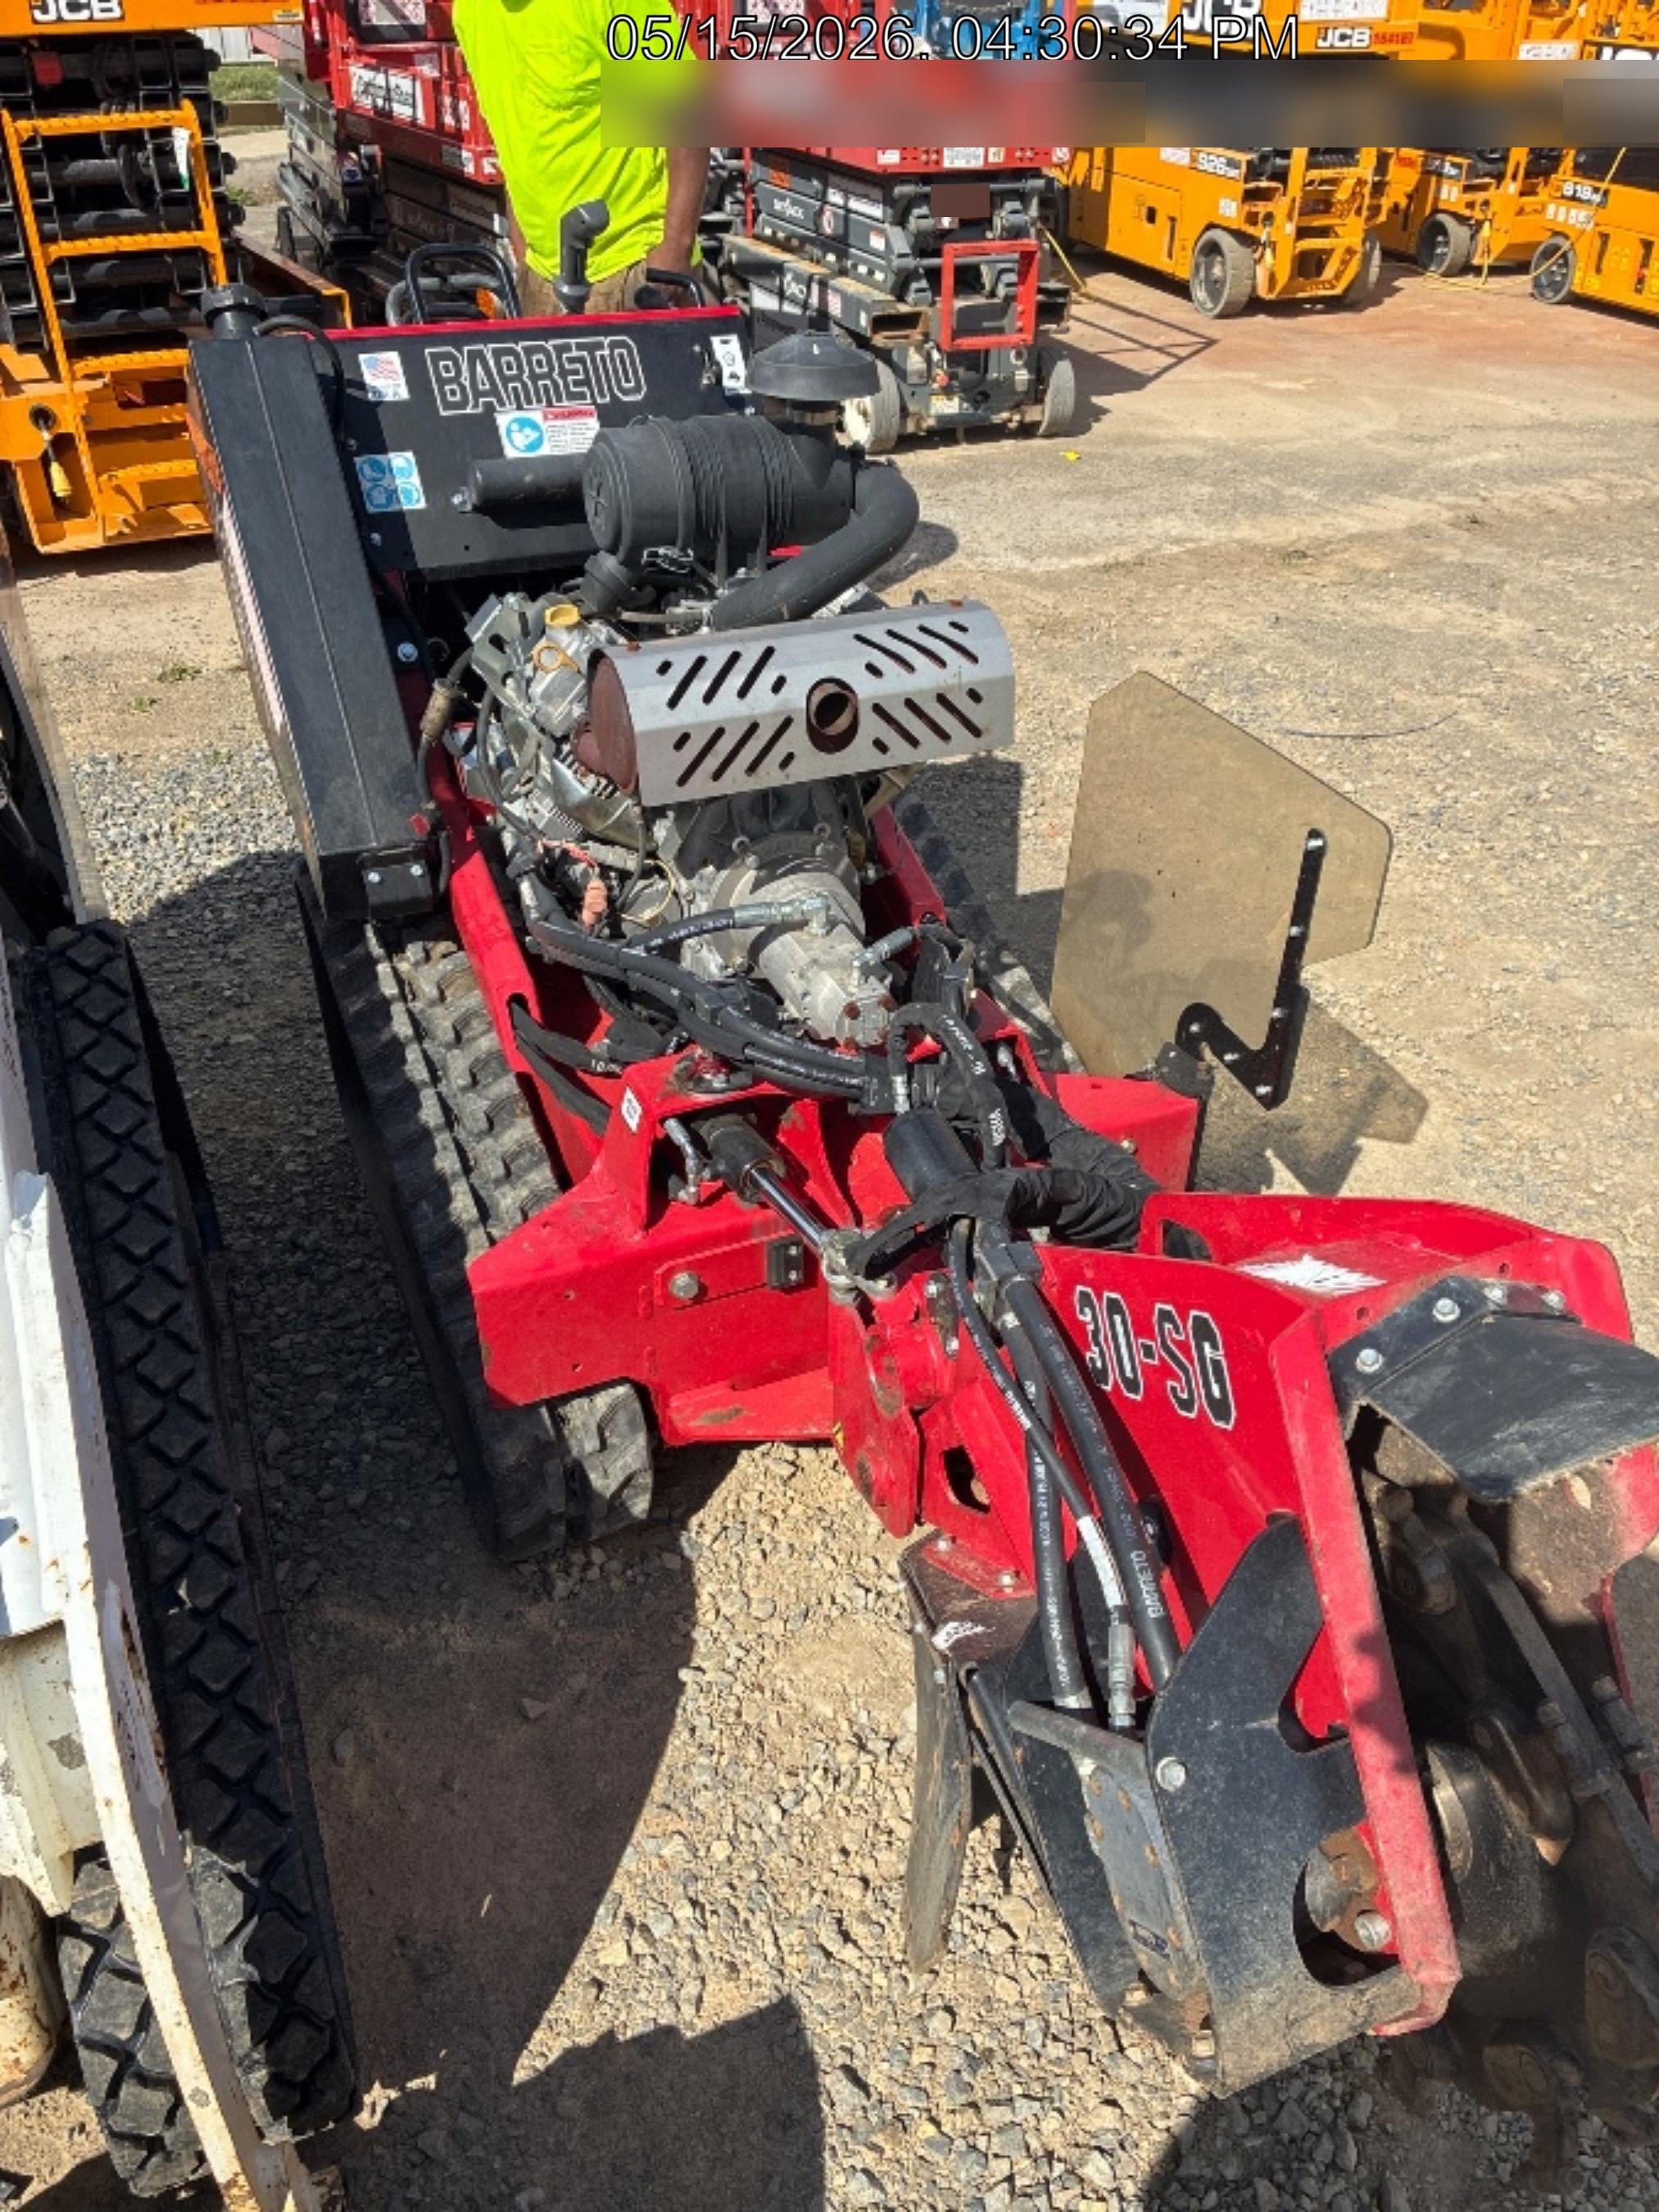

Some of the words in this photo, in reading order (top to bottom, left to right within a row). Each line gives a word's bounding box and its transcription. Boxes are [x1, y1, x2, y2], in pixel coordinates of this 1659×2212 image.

[31, 0, 123, 22] JCB
[1316, 27, 1371, 48] JCB
[425, 336, 646, 416] BARRETO
[1075, 1285, 1236, 1430] 30-SG
